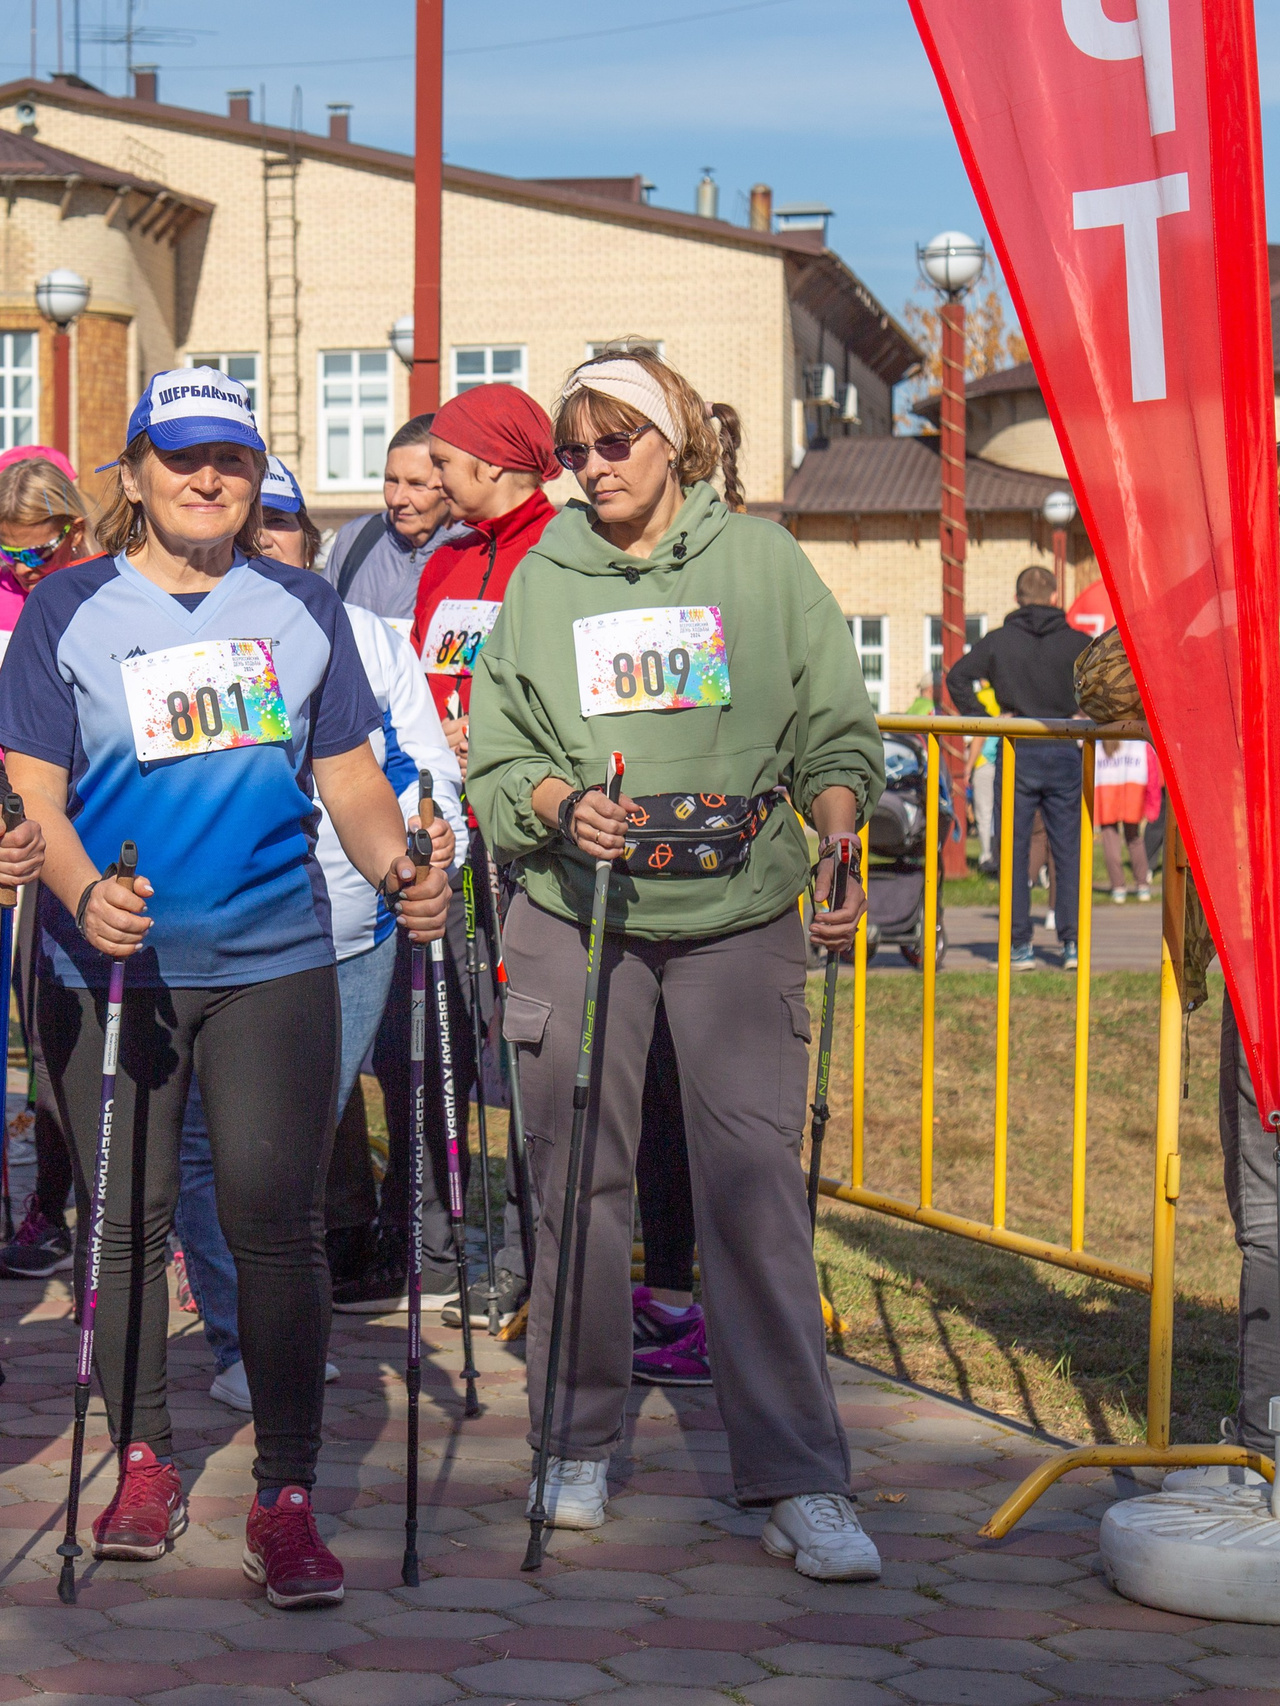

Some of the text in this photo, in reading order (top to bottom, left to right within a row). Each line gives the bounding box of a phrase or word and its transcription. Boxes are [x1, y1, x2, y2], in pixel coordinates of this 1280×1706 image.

[158, 384, 244, 408] ШЕРБАКУЛЬ
[436, 630, 482, 666] 823
[612, 647, 691, 699] 809
[166, 682, 250, 742] 801
[436, 980, 453, 1064] СЕВЕРНАЯ
[582, 999, 597, 1055] SPIN
[818, 1050, 830, 1096] SPIN
